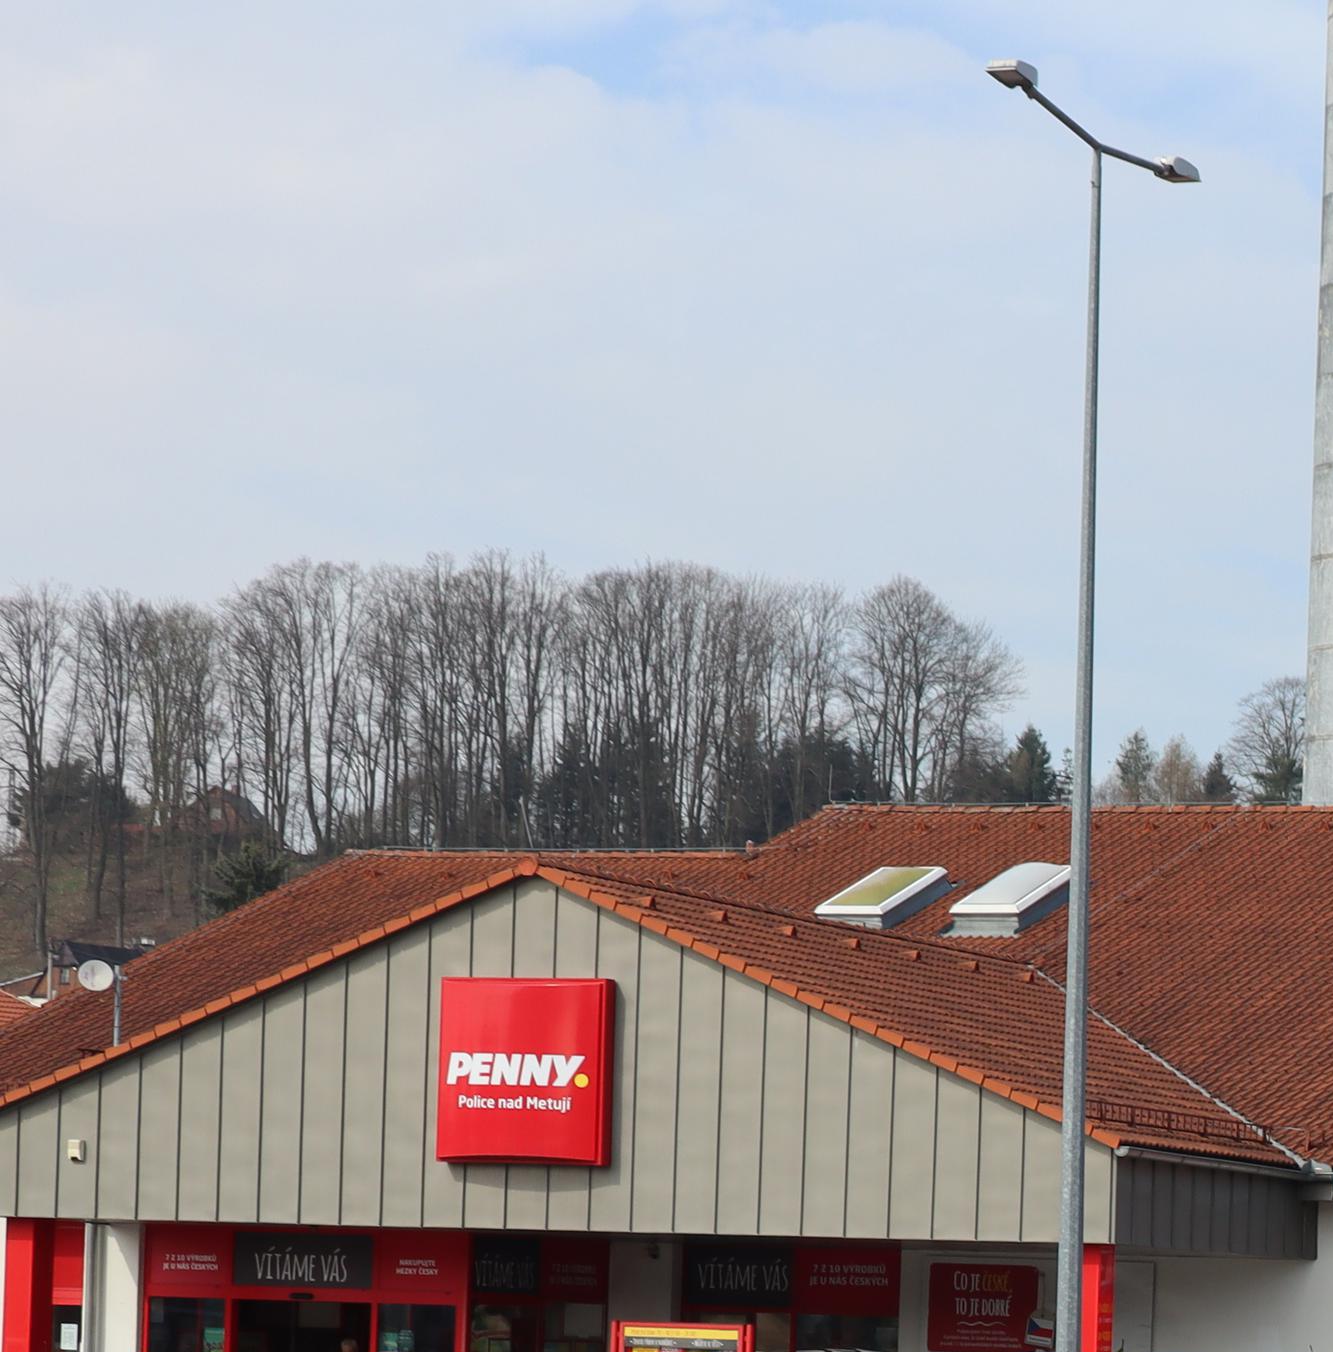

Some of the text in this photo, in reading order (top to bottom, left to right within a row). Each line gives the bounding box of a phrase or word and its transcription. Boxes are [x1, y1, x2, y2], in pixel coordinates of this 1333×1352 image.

[458, 1094, 572, 1113] Police nad Metují
[254, 1245, 348, 1283] VÍTÁME VÁS
[697, 1257, 789, 1292] VÍTÁME VÁS
[829, 1274, 847, 1286] NÁS
[953, 1271, 968, 1290] CO
[969, 1273, 980, 1292] JE
[955, 1295, 1013, 1317] TO JE DOBRÉ
